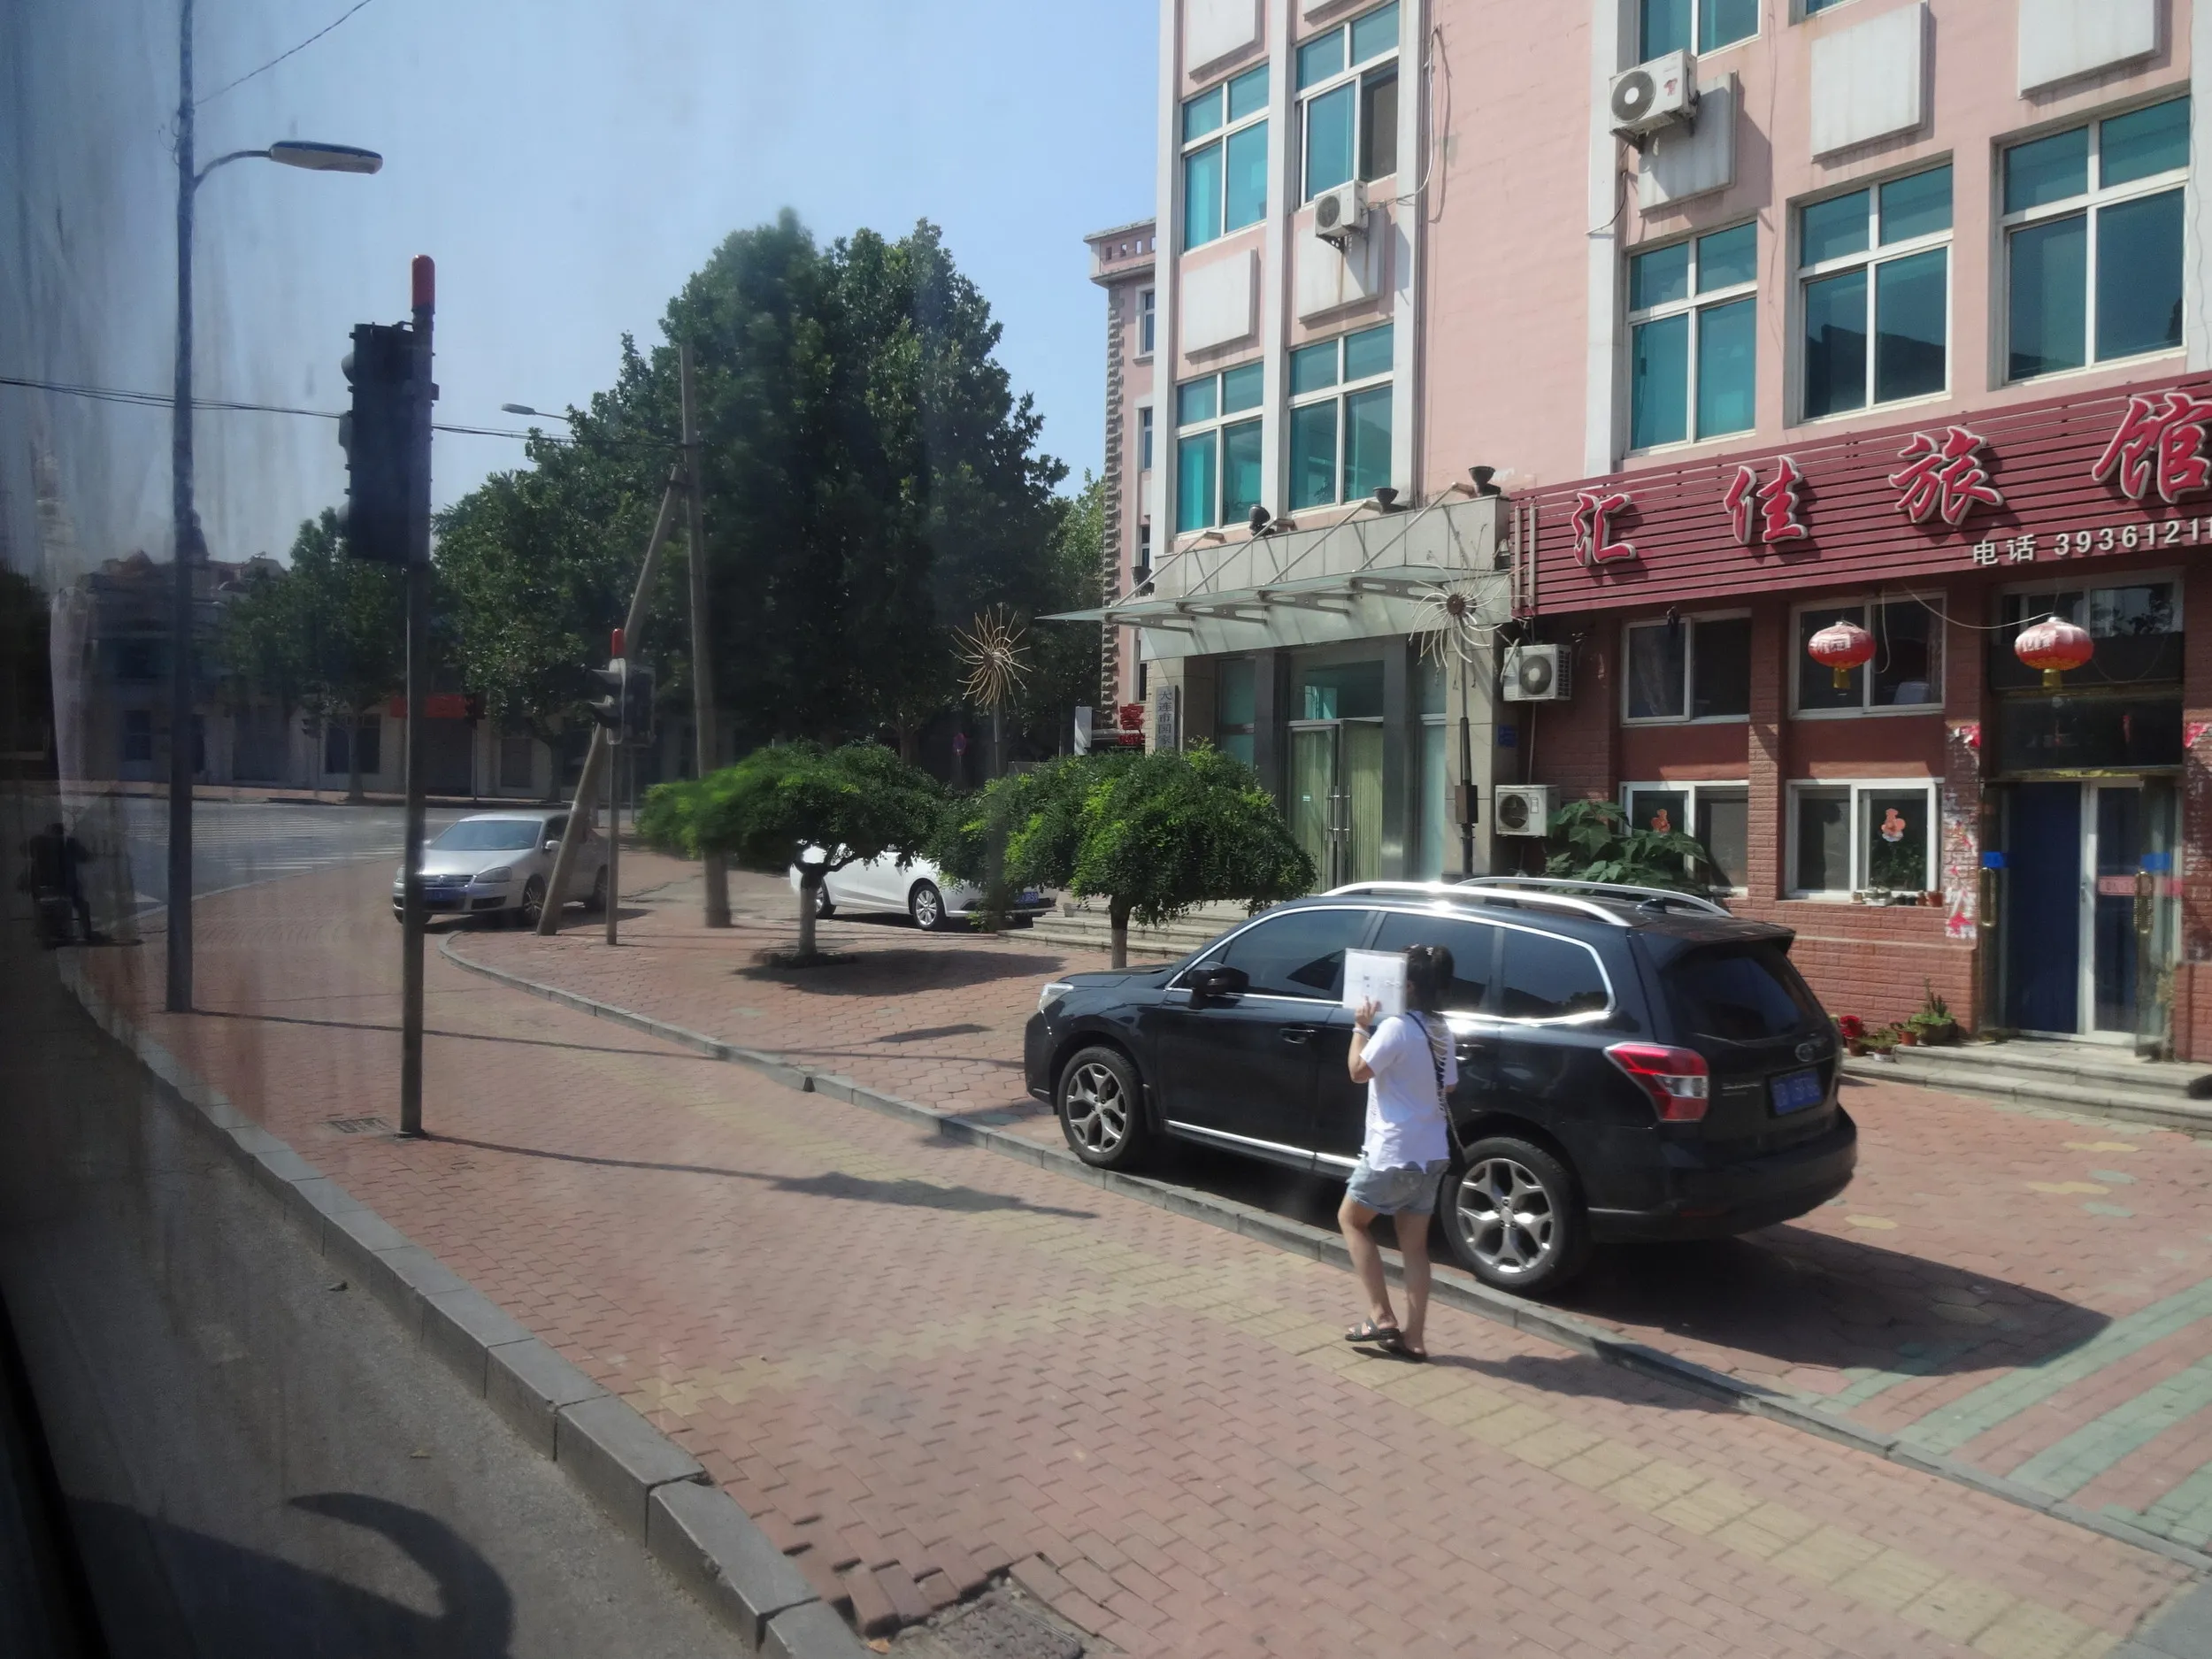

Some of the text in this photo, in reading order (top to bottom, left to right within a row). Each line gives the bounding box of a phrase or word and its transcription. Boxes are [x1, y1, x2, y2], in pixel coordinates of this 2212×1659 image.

[1571, 392, 2212, 567] 汇佳旅馆
[1973, 534, 2036, 565] 电话
